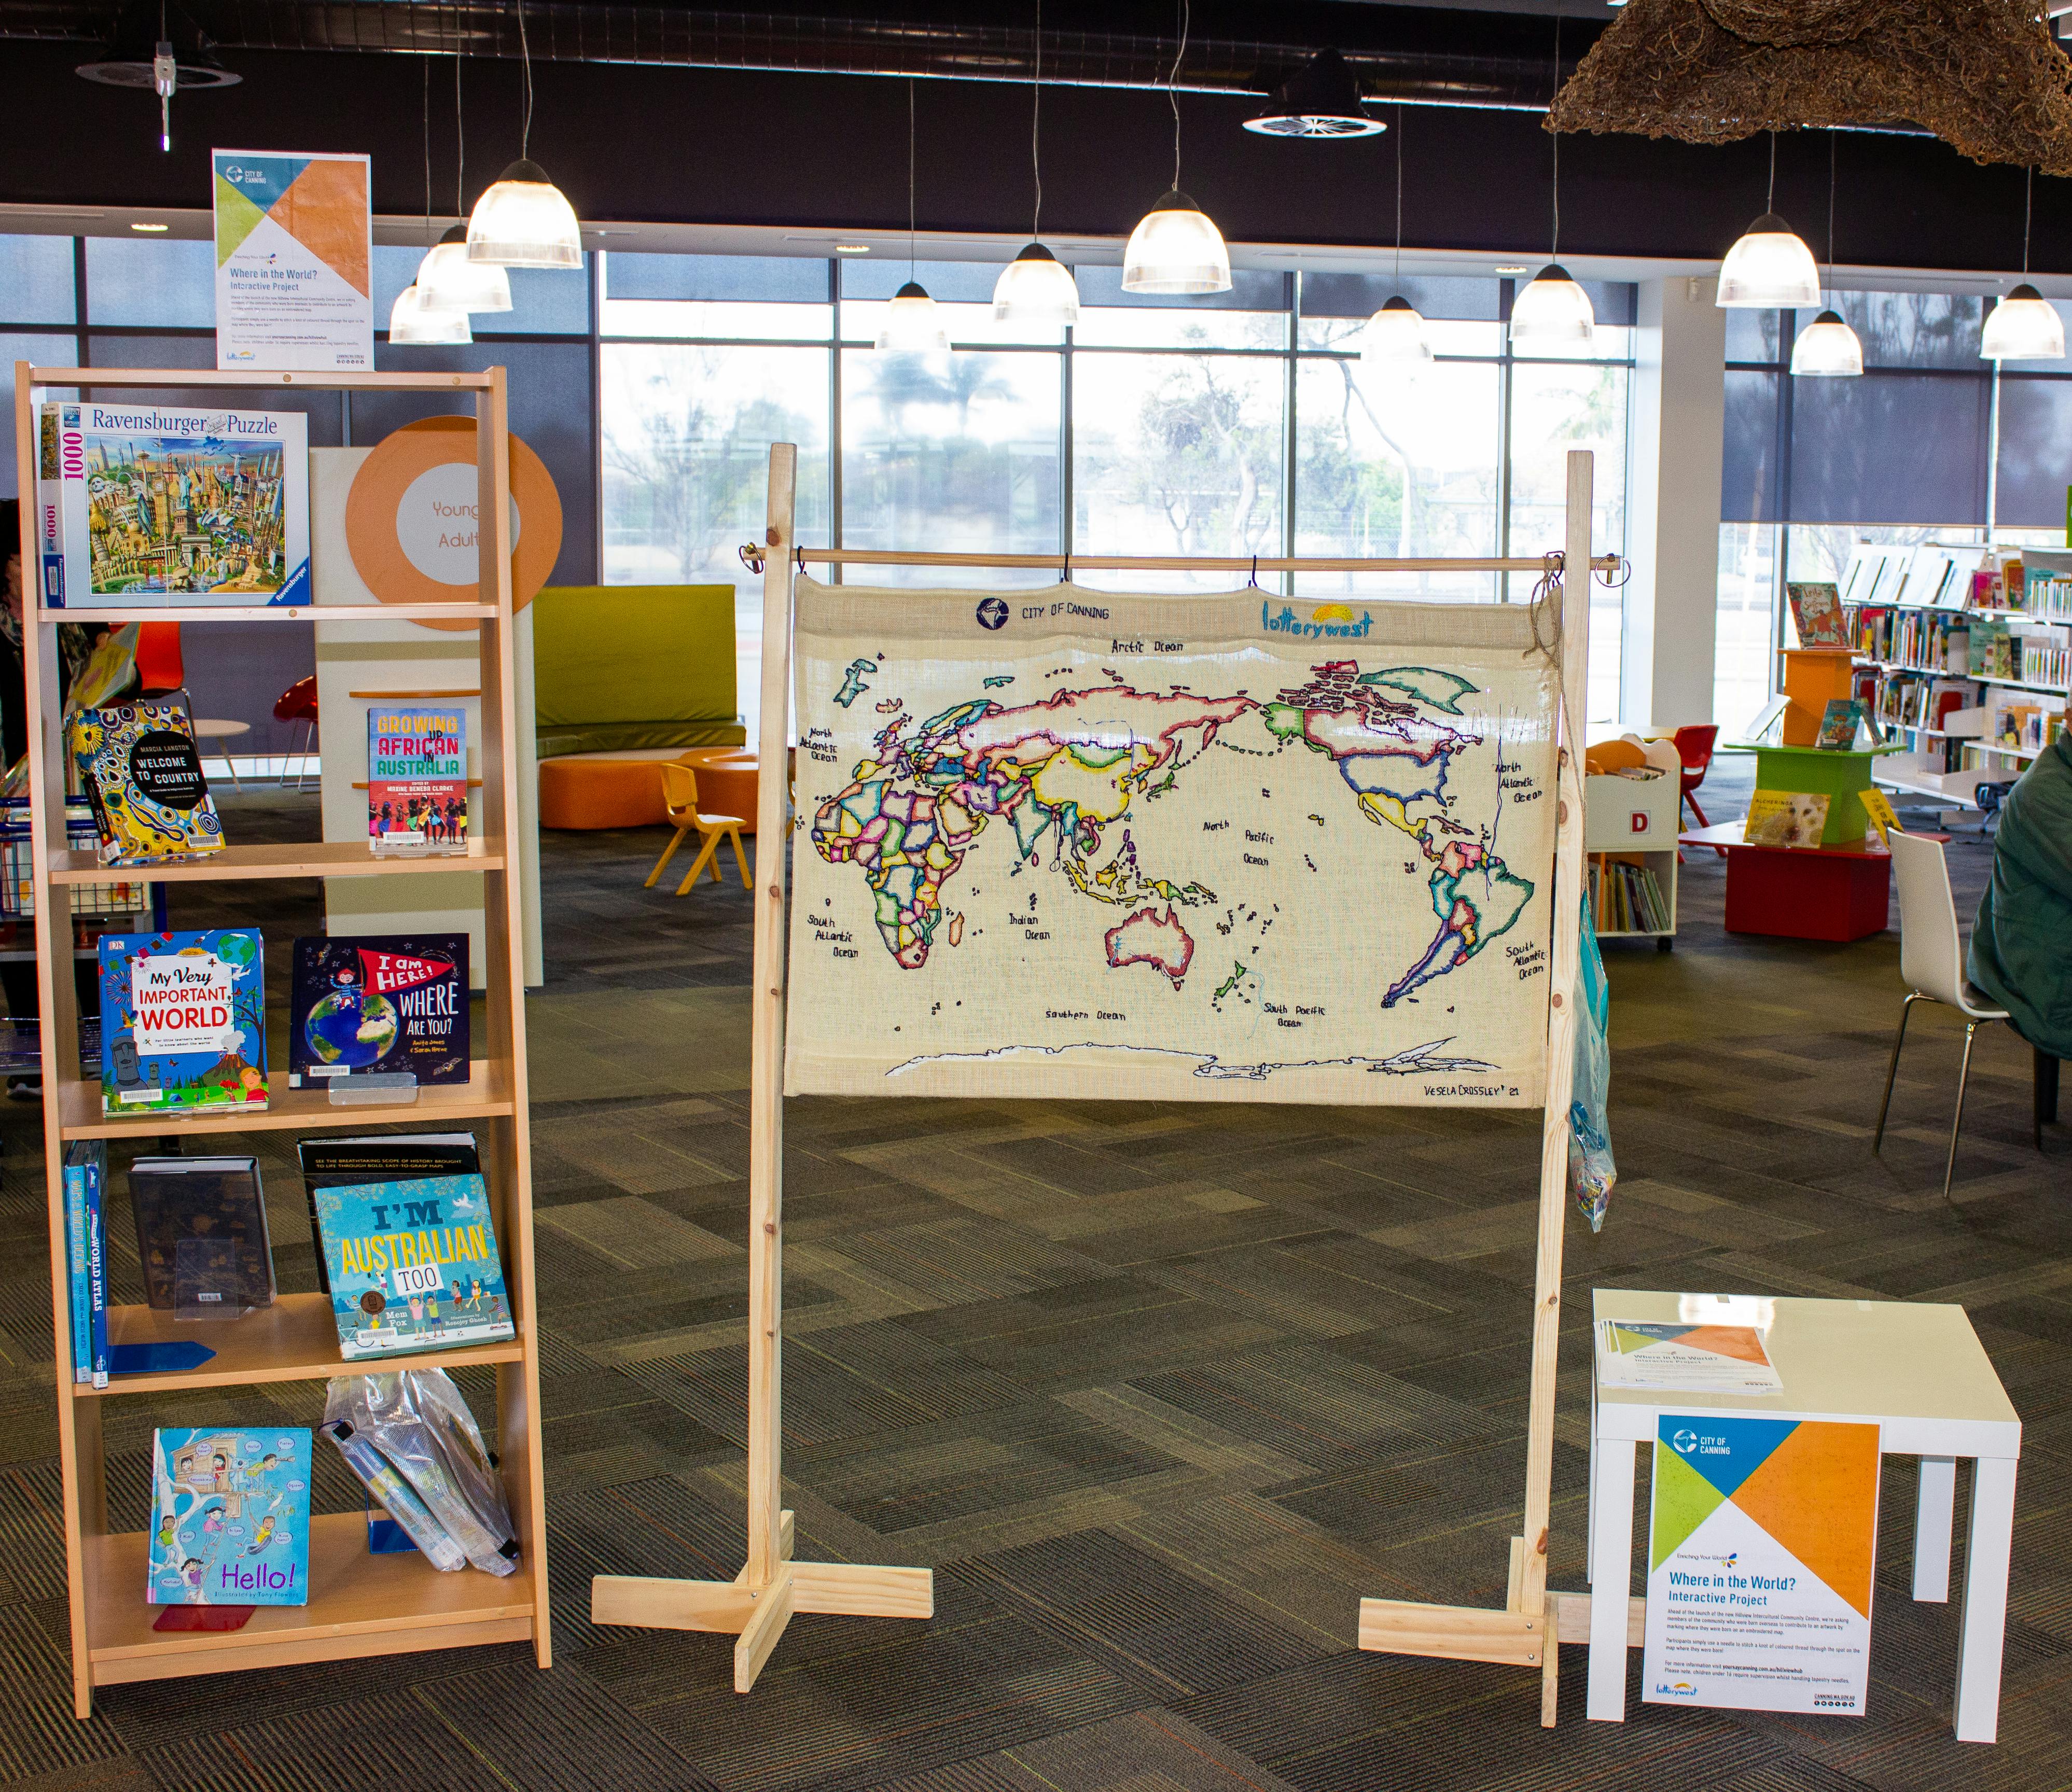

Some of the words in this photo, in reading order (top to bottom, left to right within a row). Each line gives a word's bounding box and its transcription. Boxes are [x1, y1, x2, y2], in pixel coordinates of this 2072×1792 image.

[230, 268, 258, 279] Where
[260, 269, 268, 278] in
[270, 269, 284, 279] the
[286, 269, 317, 279] World?
[231, 282, 270, 290] Interactive
[273, 283, 299, 292] Project
[227, 353, 256, 361] lotterywest
[93, 409, 206, 436] Ravensburger
[227, 416, 278, 436] Puzzle
[63, 432, 84, 481] 1000
[433, 501, 478, 519] Young
[47, 504, 56, 538] 1000
[275, 566, 308, 603] Ravensburger
[1022, 607, 1045, 619] CITY
[1051, 603, 1065, 616] OF
[1066, 602, 1109, 620] CANNING
[1262, 601, 1374, 639] lotterywest
[1111, 640, 1144, 654] Arctic
[1154, 642, 1184, 653] Ocean
[378, 716, 458, 733] GROWING
[428, 730, 443, 741] UP
[810, 727, 832, 738] North
[379, 737, 458, 755] AFRICAN
[799, 738, 837, 752] Atlantic
[136, 757, 187, 768] WELCOME
[424, 753, 434, 763] IN
[812, 750, 837, 762] Ocean
[377, 760, 460, 775] AUSTRALIA
[1495, 762, 1522, 774] North
[136, 771, 151, 780] TO
[155, 773, 199, 784] COUNTRY
[1499, 777, 1534, 790] Atlantic
[1514, 789, 1542, 803] Ocean
[1203, 820, 1229, 832] North
[1632, 813, 1648, 832] D
[1245, 830, 1274, 844] Pacific
[1244, 853, 1269, 866] Ocean
[808, 914, 836, 928] South
[1009, 913, 1038, 925] Indian
[815, 930, 853, 943] Atlantic
[1025, 929, 1050, 940] Ocean
[110, 941, 124, 950] DK
[833, 946, 858, 958] Ocean
[1506, 942, 1535, 957] South
[379, 955, 390, 970] I
[395, 958, 422, 969] am
[1513, 949, 1546, 967] Atlantic
[150, 972, 172, 987] My
[174, 967, 214, 986] Very
[377, 965, 434, 991] HERE!
[1519, 964, 1543, 981] Ocean
[140, 986, 227, 1004] IMPORTANT
[399, 982, 459, 1017] WHERE
[1046, 1009, 1089, 1019] Southern
[1096, 1011, 1126, 1021] Ocean
[1264, 1002, 1288, 1014] South
[1296, 1006, 1326, 1016] Pacific
[141, 1006, 228, 1031] WORLD
[1277, 1018, 1302, 1027] Ocean
[407, 1020, 425, 1035] ARE
[427, 1018, 452, 1035] YOU?
[371, 1200, 443, 1230] I'M
[342, 1224, 489, 1275] AUSTRALIAN
[91, 1239, 101, 1277] WORLD
[398, 1267, 437, 1291] TOO
[92, 1280, 103, 1311] ATLAS
[386, 1311, 408, 1320] Mem
[390, 1318, 407, 1327] Fox
[1700, 1436, 1716, 1446] CITY
[1700, 1446, 1731, 1455] CANNING
[222, 1563, 296, 1590] Hello!
[1669, 1572, 1709, 1586] Where
[1713, 1574, 1723, 1587] in
[1728, 1574, 1747, 1588] the
[1750, 1576, 1796, 1591] World?
[1668, 1590, 1726, 1604] Interactive
[1730, 1594, 1768, 1607] Project
[1656, 1683, 1698, 1697] lotterywest
